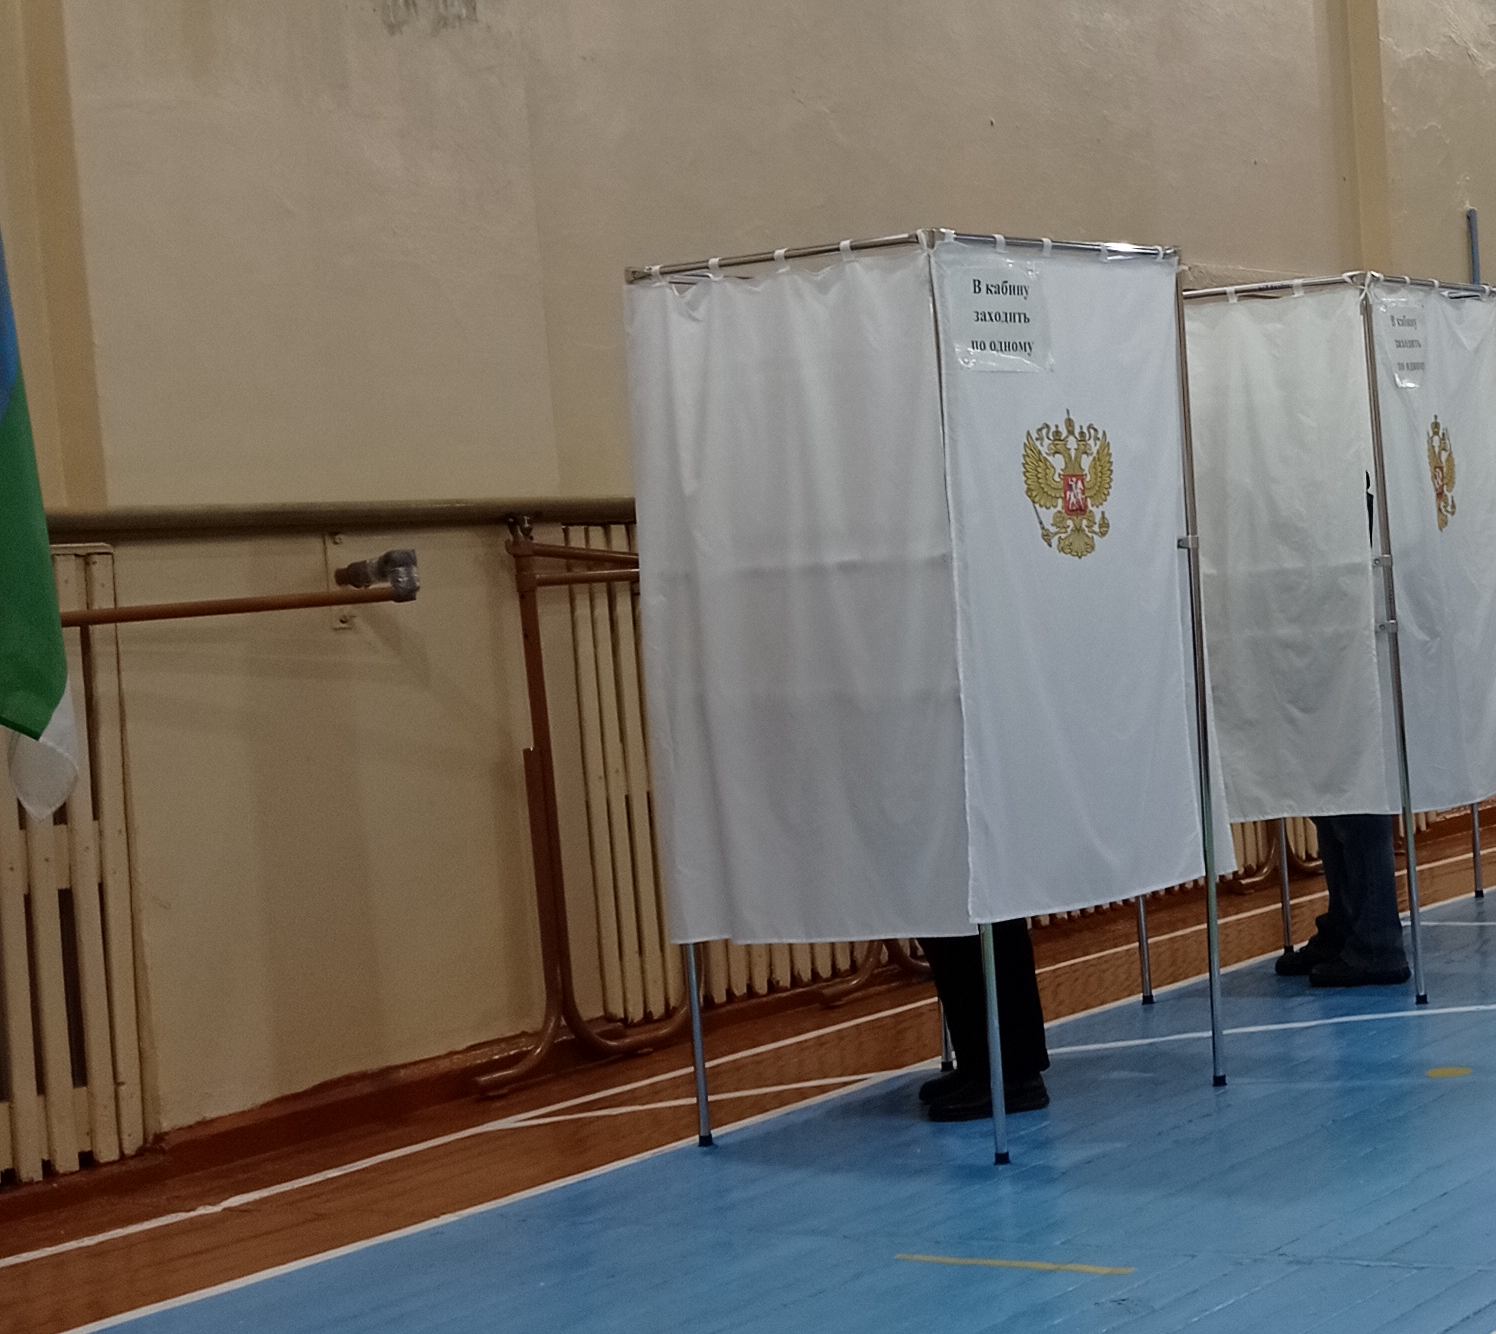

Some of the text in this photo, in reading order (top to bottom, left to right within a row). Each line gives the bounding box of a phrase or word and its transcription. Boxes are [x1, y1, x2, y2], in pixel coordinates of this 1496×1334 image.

[973, 278, 1029, 300] В кабину
[973, 310, 1030, 324] заходить
[971, 340, 1034, 356] по одному
